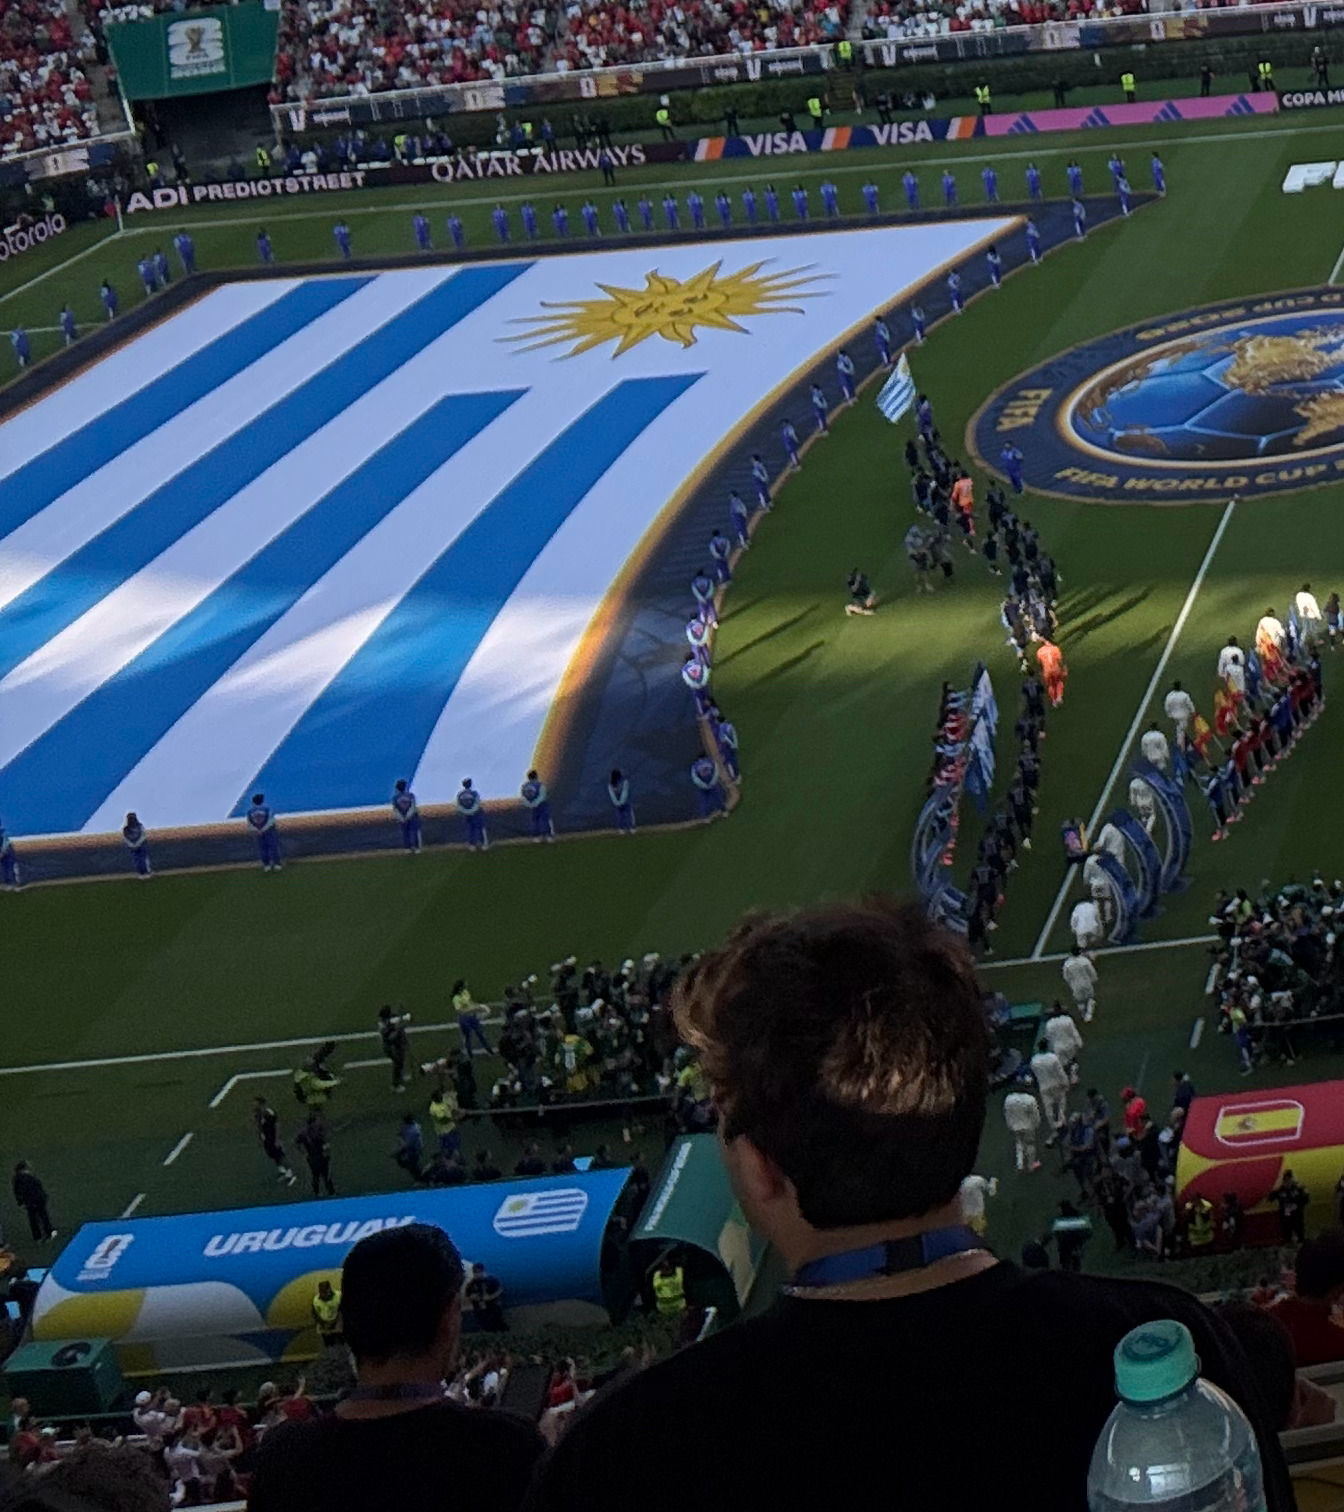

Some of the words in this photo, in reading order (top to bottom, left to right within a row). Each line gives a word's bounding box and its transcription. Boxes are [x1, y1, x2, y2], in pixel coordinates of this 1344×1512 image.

[1282, 91, 1326, 109] COPA
[742, 131, 809, 157] VISA
[870, 120, 934, 146] VISA
[432, 153, 523, 183] QATAR
[533, 144, 647, 174] AIRWAYS
[126, 185, 189, 214] ADI
[0, 213, 66, 262] otorola
[1054, 465, 1119, 488] FIFA
[1122, 475, 1250, 492] WORLD
[1255, 463, 1328, 486] CUP
